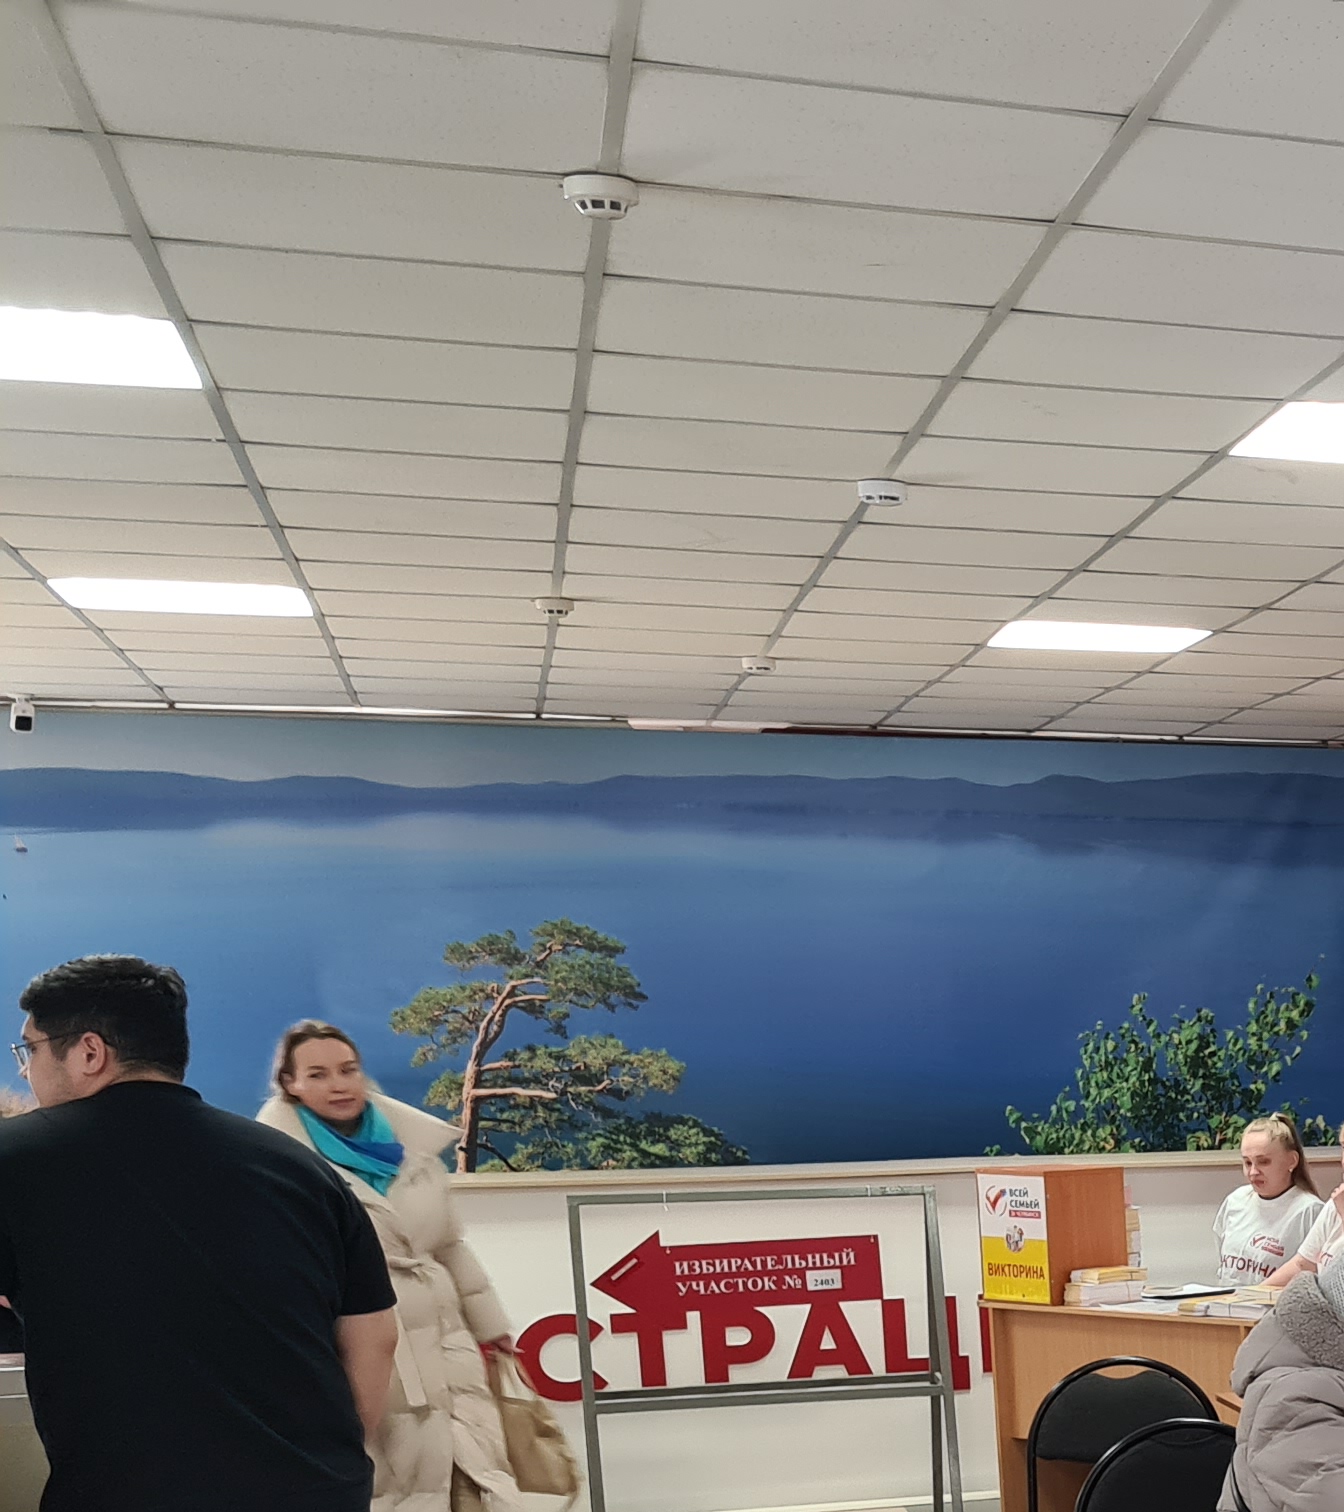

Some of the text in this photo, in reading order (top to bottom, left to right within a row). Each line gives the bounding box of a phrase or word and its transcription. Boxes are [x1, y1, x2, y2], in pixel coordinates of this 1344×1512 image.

[1009, 1187, 1028, 1198] ВСЕЙ
[1009, 1199, 1040, 1209] СЕМЬЕЙ
[674, 1248, 856, 1276] ИЗБИРАТЕЛЬНЫЙ
[987, 1262, 1045, 1280] ВИКТОРИНА
[676, 1275, 835, 1296] УЧАСТОК № 2403
